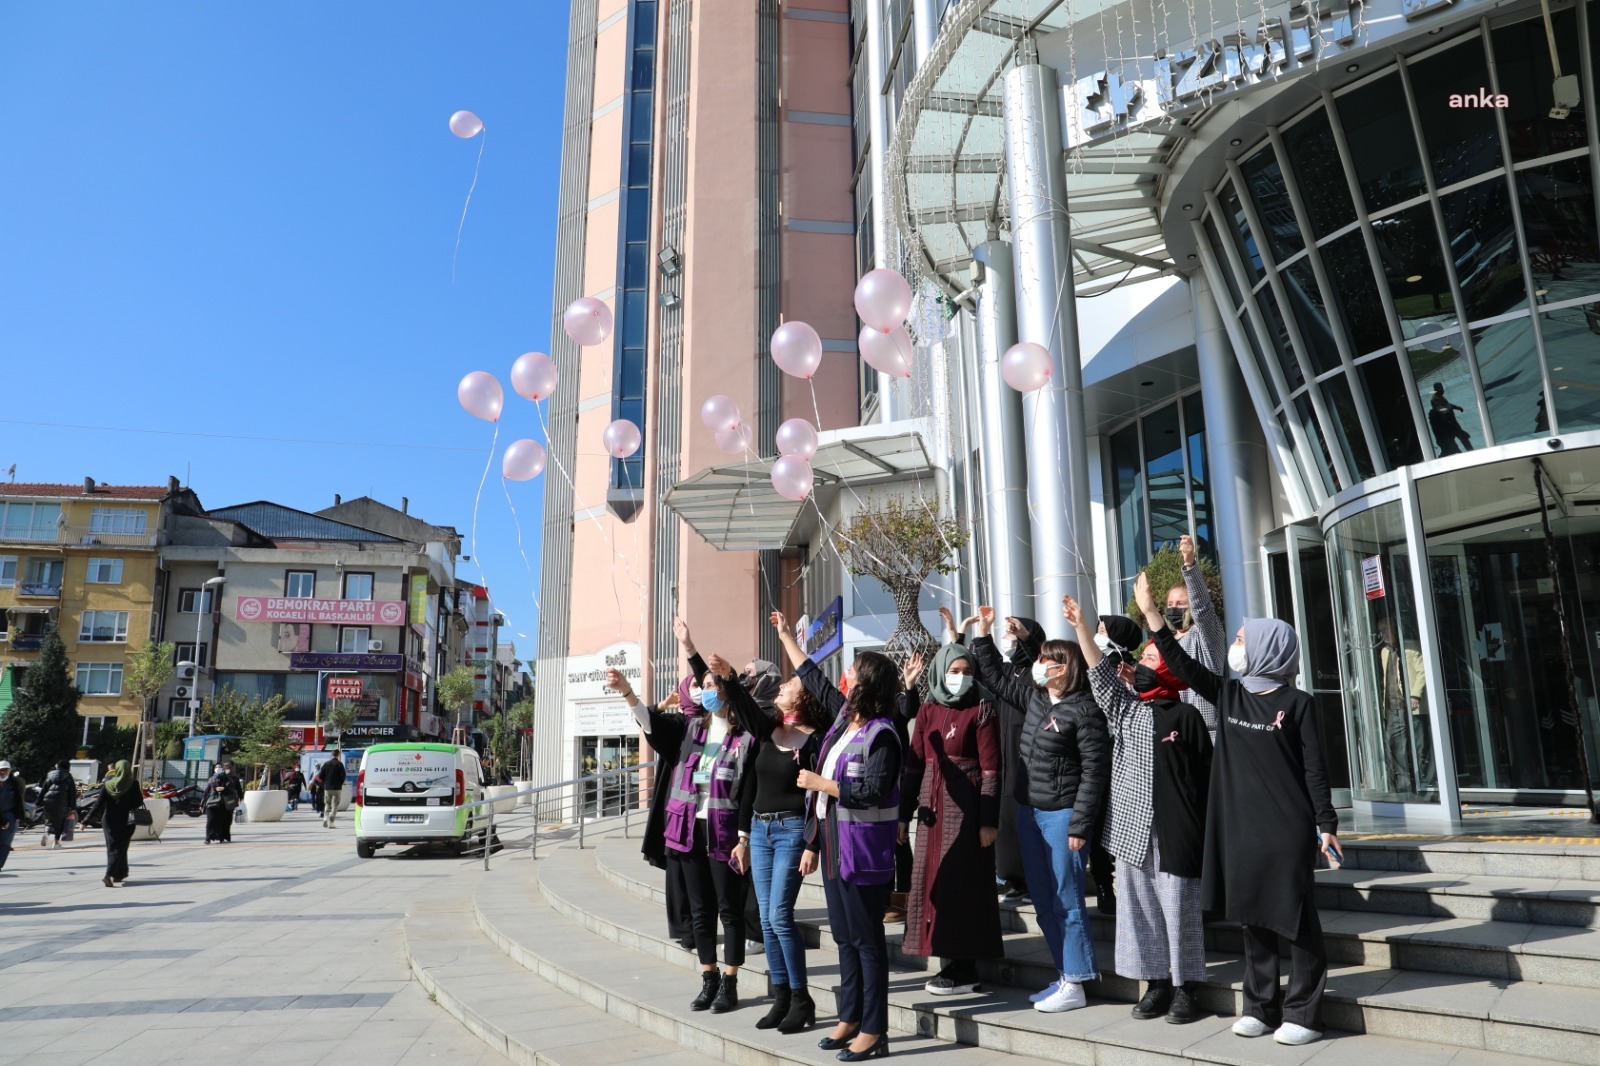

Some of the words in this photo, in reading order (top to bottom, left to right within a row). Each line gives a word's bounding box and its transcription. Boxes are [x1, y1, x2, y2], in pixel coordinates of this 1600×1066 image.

[267, 599, 336, 611] DEMOKRAT
[318, 613, 375, 622] BAŞKANLIĞI
[329, 678, 360, 686] BELSA
[329, 685, 360, 695] TAKSİ
[1228, 716, 1238, 724] YOU
[1239, 720, 1251, 728] ARE
